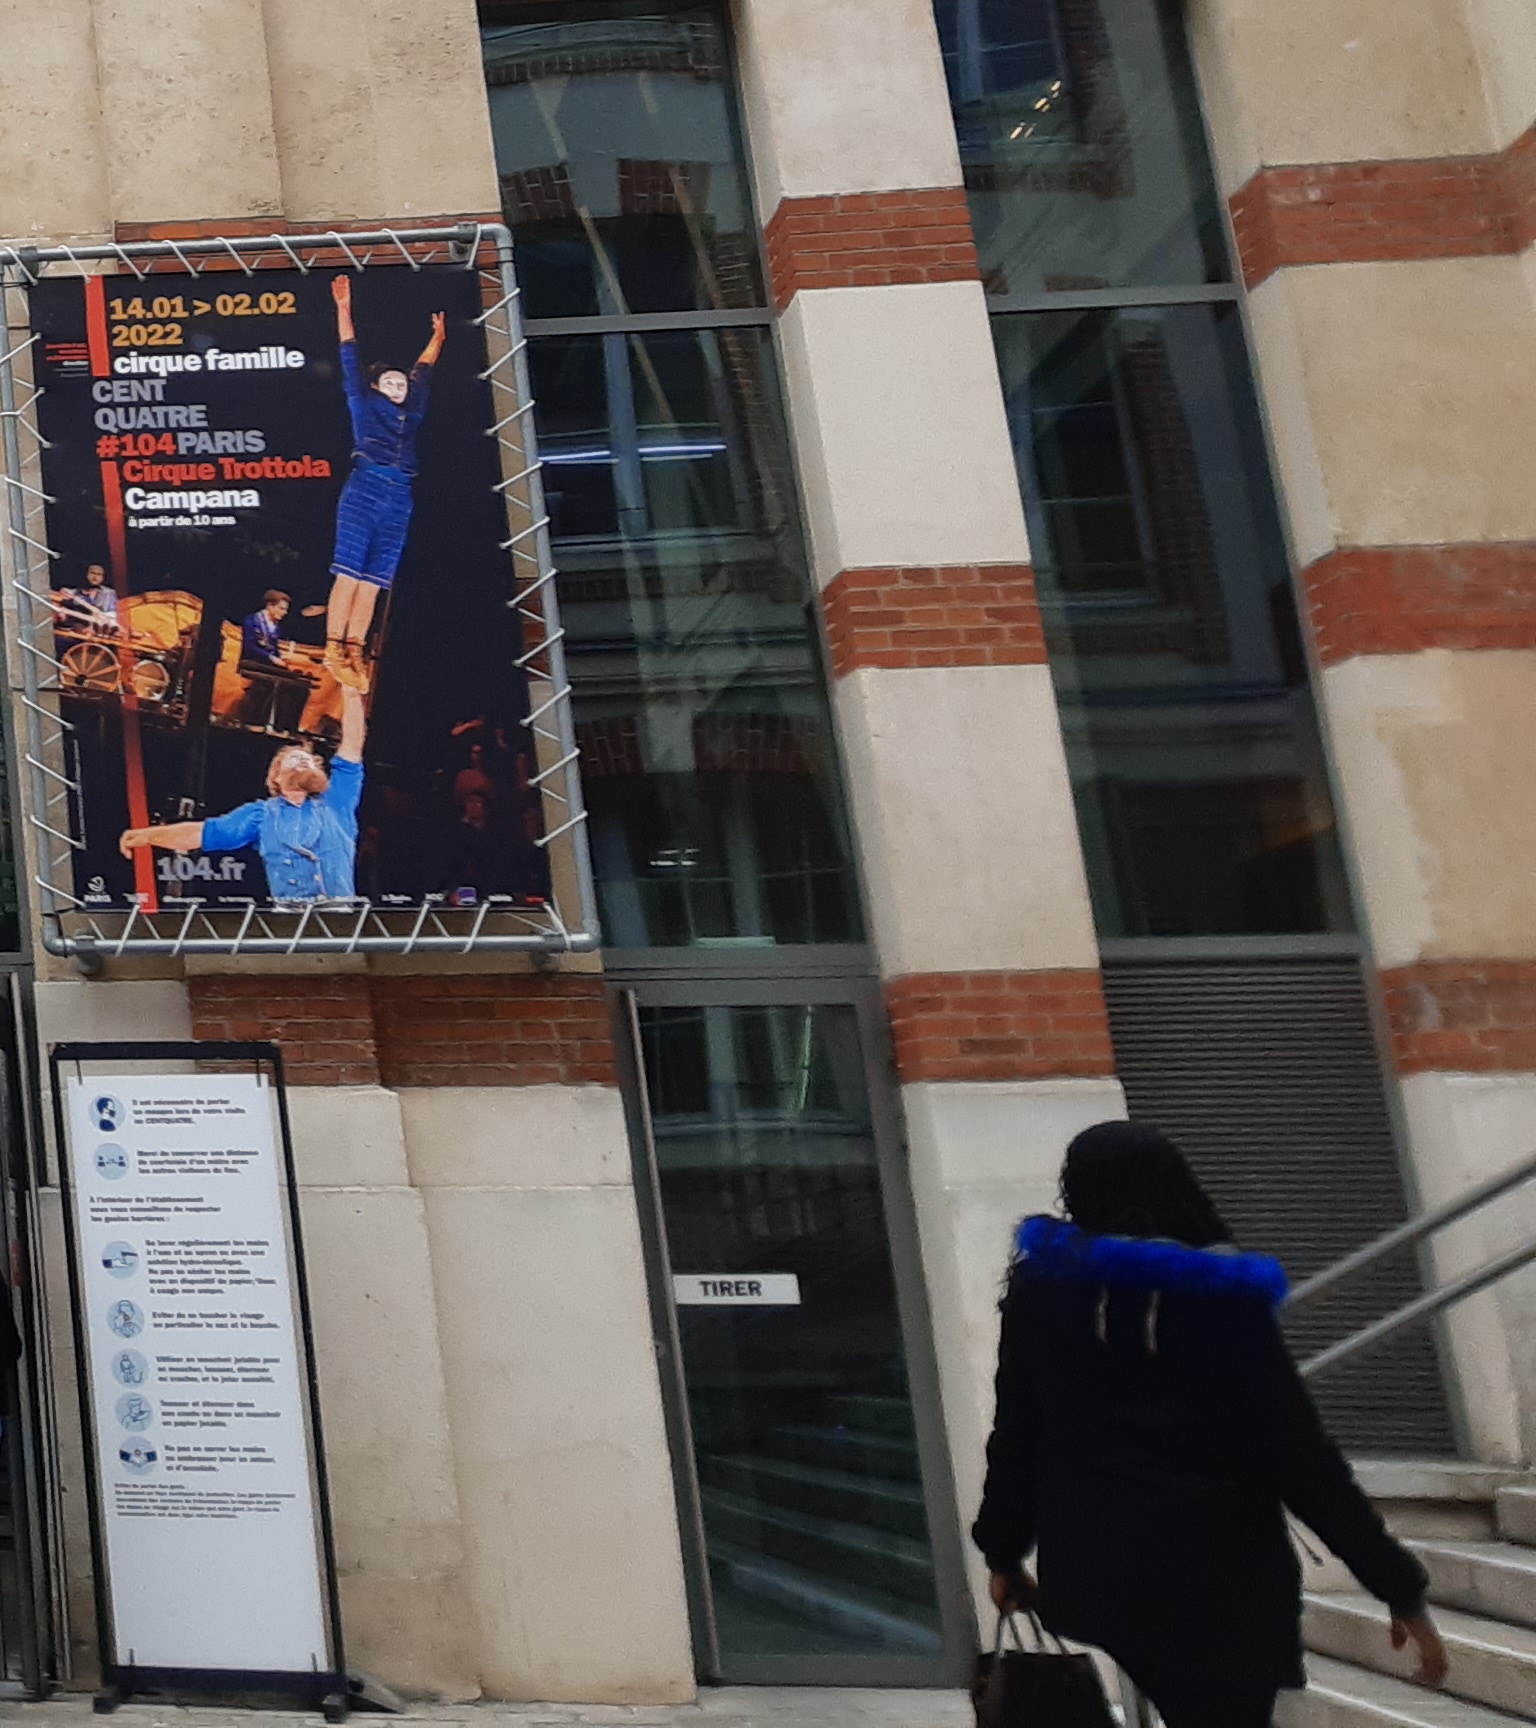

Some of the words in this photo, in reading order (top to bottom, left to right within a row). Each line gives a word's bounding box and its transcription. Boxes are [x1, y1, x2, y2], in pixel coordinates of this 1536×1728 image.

[109, 295, 188, 320] 14.01
[215, 292, 296, 316] 02.02
[112, 323, 183, 346] 2022
[113, 351, 201, 376] cirque
[204, 346, 305, 370] famille
[92, 378, 166, 403] CENT
[94, 404, 207, 433] QUATRE
[122, 459, 215, 485] Cirque
[218, 454, 331, 479] Trottola
[125, 487, 260, 512] Campana
[156, 854, 246, 884] 104.fr
[699, 1279, 762, 1296] TIRER
